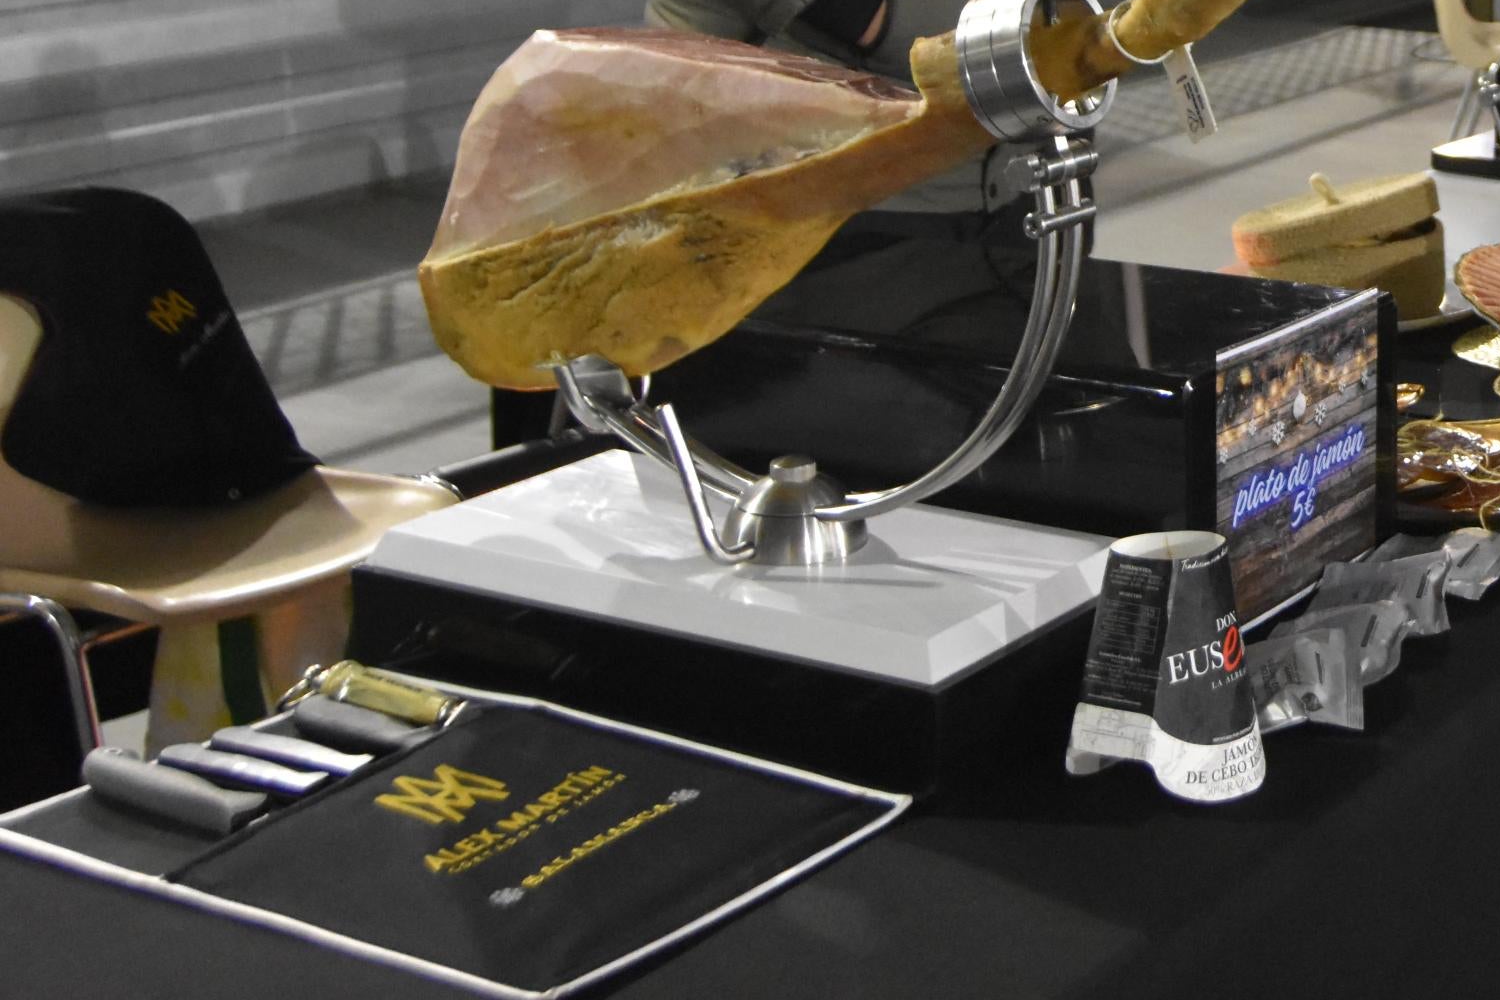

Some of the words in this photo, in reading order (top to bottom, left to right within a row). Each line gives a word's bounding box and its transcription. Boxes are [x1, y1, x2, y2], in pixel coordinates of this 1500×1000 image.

[1233, 471, 1284, 527] plato
[1288, 453, 1312, 488] de
[1307, 426, 1366, 488] jamón
[1291, 487, 1317, 527] 5€
[1185, 771, 1208, 785] DE
[1211, 761, 1247, 782] CEBO
[423, 828, 506, 873] ALEX
[496, 765, 613, 831] MARTÍN
